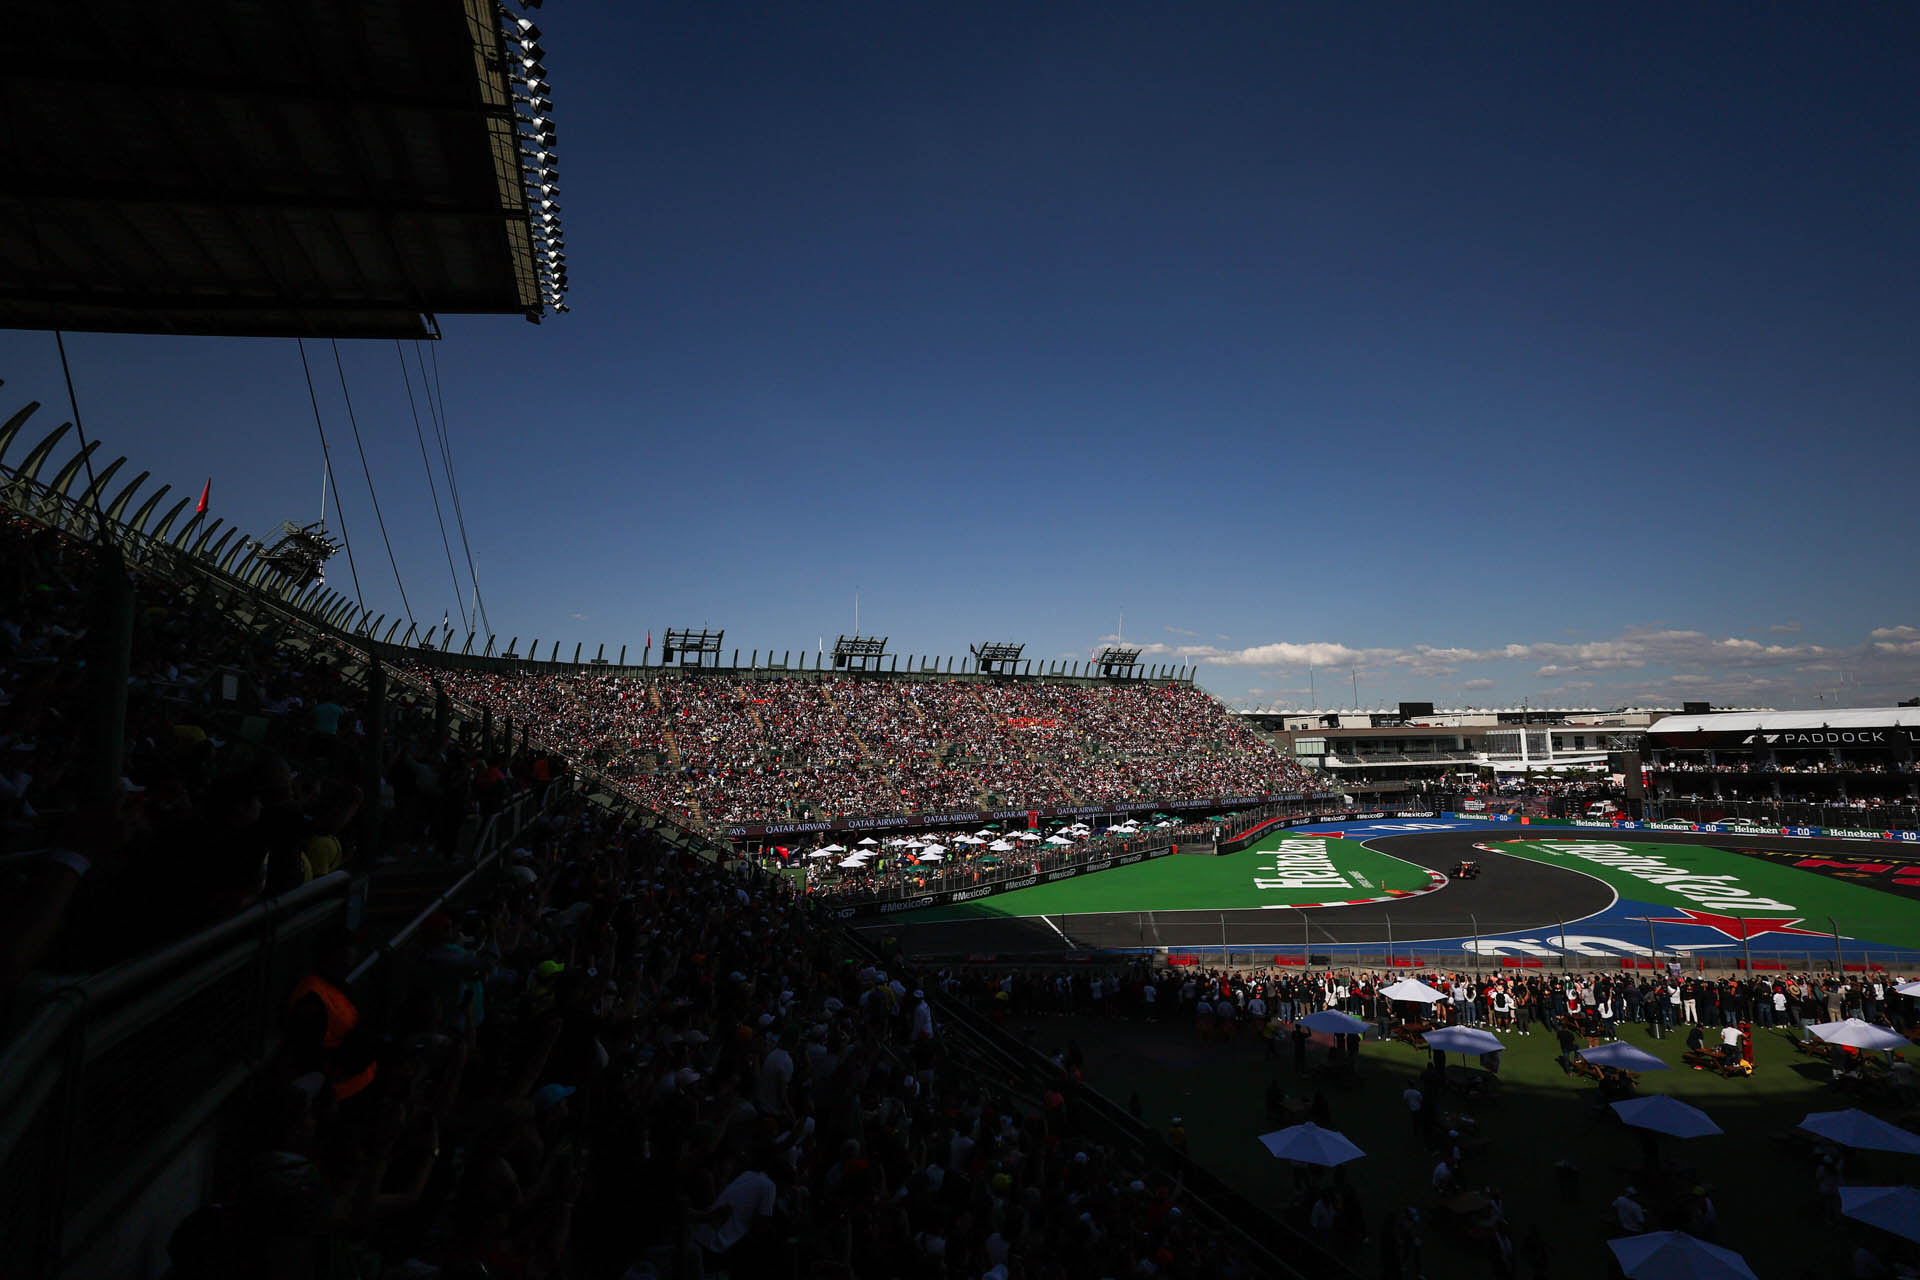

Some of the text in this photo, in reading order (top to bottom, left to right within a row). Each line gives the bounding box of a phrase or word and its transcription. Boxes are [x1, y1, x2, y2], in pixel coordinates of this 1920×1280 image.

[1785, 732, 1885, 744] PADDOCK
[1116, 802, 1159, 811] QATAR AIRWAYS
[951, 813, 979, 822] AIRWAYS
[993, 811, 1016, 819] QATAR
[765, 822, 832, 834] QATAR AIRWAYS
[848, 817, 909, 828] QATAR AIRWAYS
[1576, 820, 1610, 828] Heineken
[1650, 822, 1689, 831] Heineken
[1734, 825, 1778, 834] Heineken
[1830, 829, 1880, 838] Heineken
[1253, 839, 1354, 889] Heineken
[1049, 868, 1077, 880] #MexicoGP
[1542, 843, 1797, 911] Heineken
[1005, 877, 1037, 890] #MexicoGP
[952, 886, 992, 902] #MexicoGP
[881, 897, 934, 913] #MexicoGP
